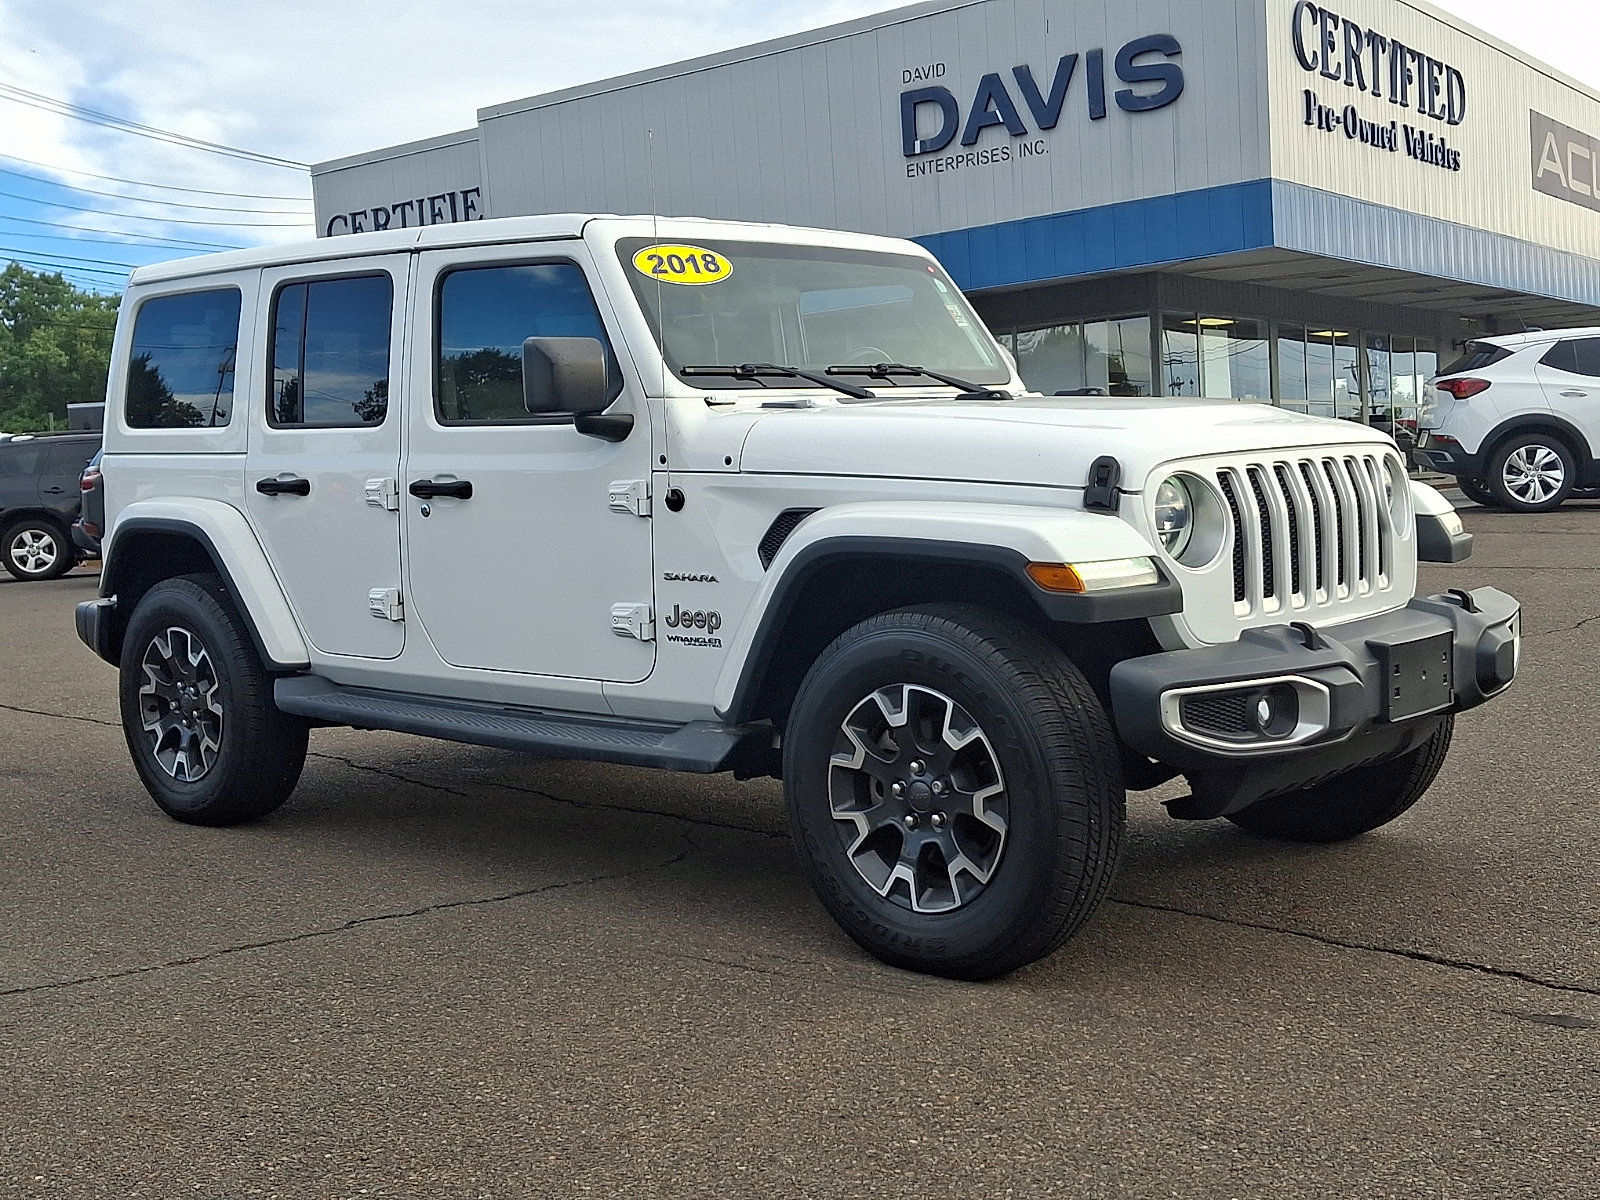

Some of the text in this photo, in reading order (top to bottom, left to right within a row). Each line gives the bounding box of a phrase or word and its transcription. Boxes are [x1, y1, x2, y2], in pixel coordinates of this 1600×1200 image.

[902, 62, 946, 84] DAVID
[1292, 0, 1466, 126] CERTIFIED
[900, 33, 1185, 158] DAVIS
[1303, 89, 1461, 171] Pre-Owned Vehicles
[906, 139, 1050, 178] ENTERPRISES, INC.
[646, 253, 720, 274] 2018
[663, 572, 720, 583] SAHARA
[665, 603, 722, 634] Jeep
[667, 634, 722, 644] WRANGLER
